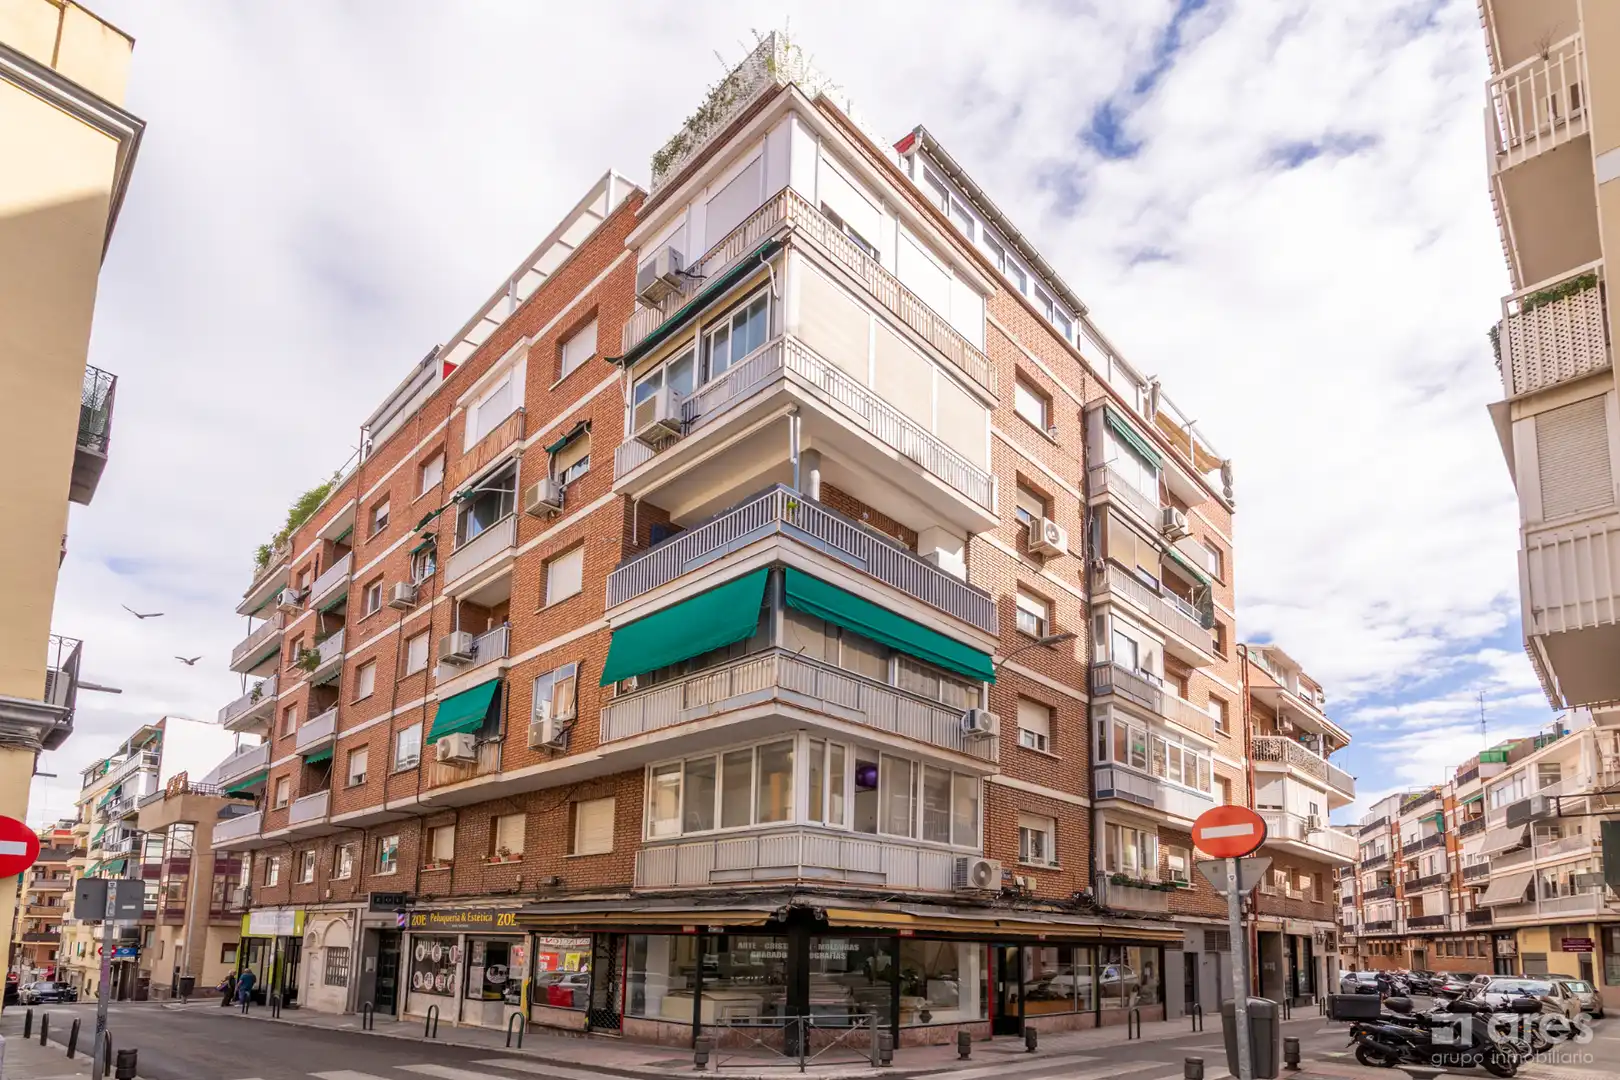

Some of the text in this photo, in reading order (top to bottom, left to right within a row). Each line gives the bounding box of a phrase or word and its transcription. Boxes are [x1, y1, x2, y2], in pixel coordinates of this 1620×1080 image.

[411, 914, 427, 926] ZOE
[430, 911, 493, 924] Peluquería & Estética
[764, 942, 789, 950] CRIST
[818, 943, 860, 951] MOLDURAS
